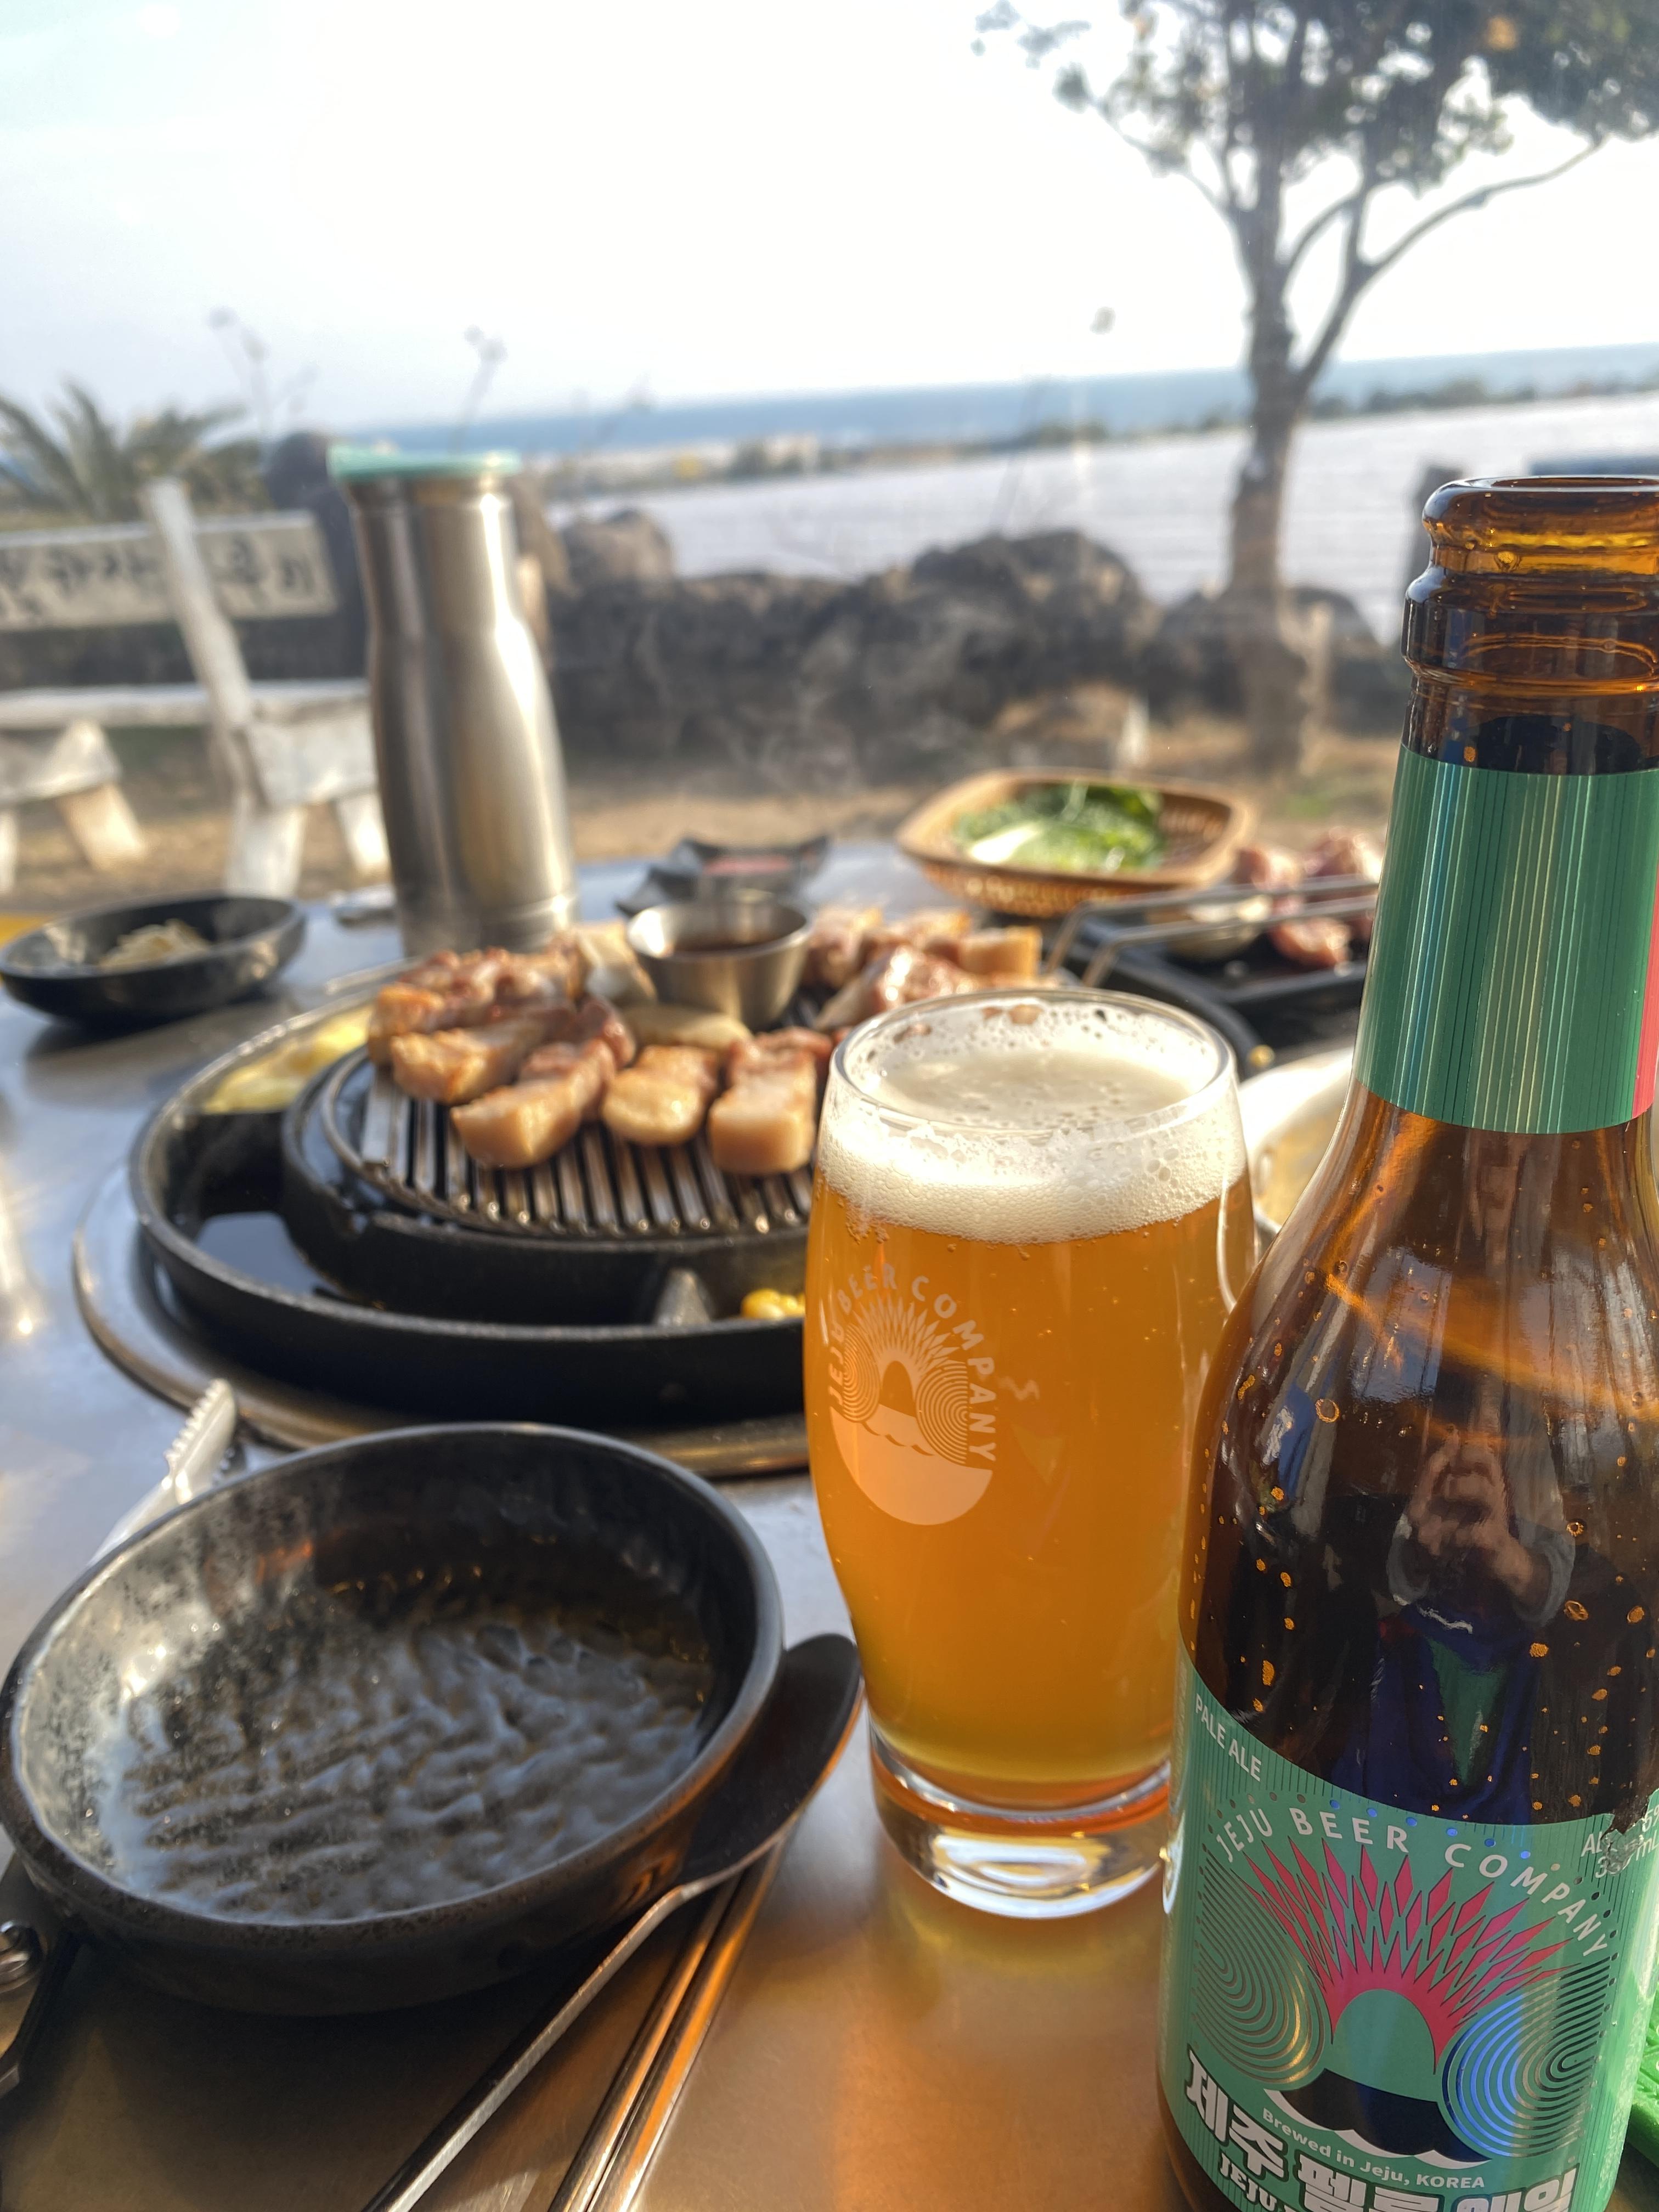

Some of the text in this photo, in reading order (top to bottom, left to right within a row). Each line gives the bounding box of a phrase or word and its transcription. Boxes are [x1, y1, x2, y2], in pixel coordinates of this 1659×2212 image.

[828, 1262, 997, 1462] JEJU BEER COMPANY
[1195, 1693, 1262, 1782] PALE ALE
[1216, 1808, 1273, 1863] JEJU
[1289, 1807, 1409, 1853] BEER
[1444, 1843, 1607, 1957] COMPANY
[1186, 2049, 1284, 2178] 제주
[1263, 2108, 1485, 2189] Brewed in Jeju, KOREA
[1220, 2152, 1278, 2211] JEJU
